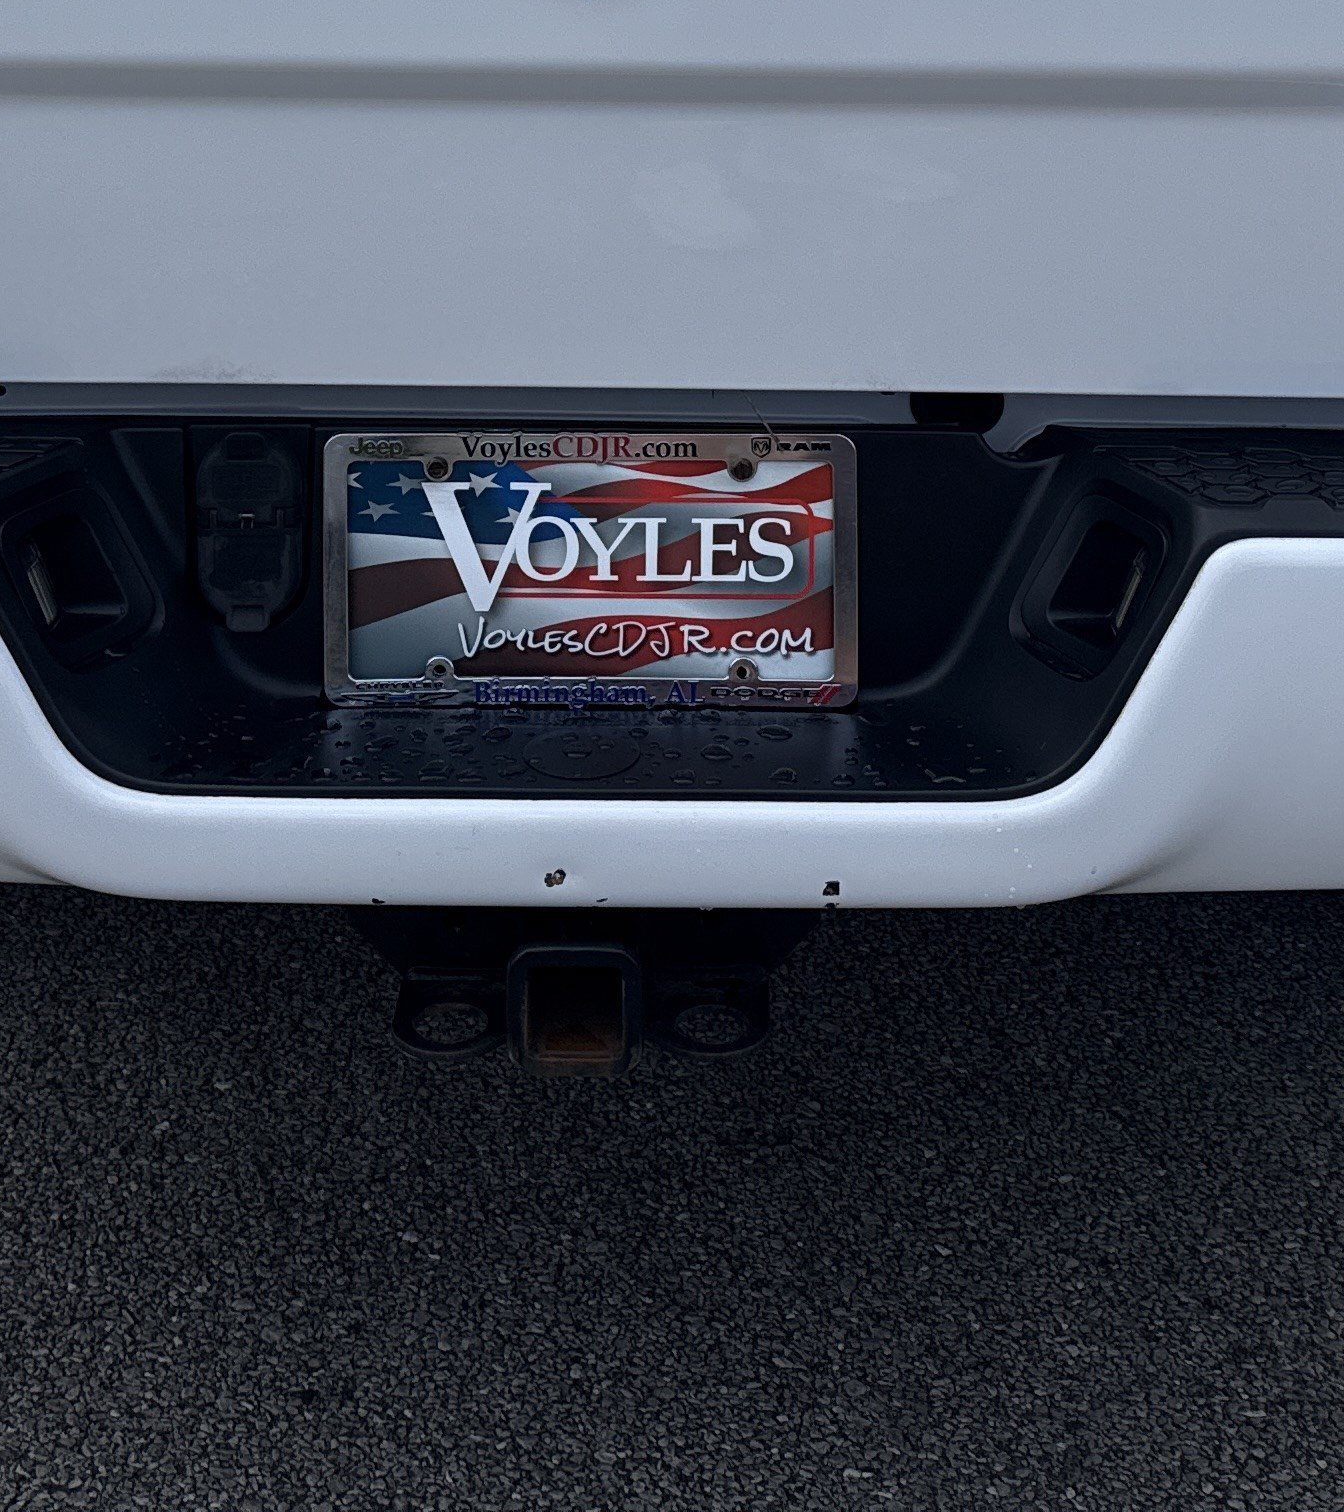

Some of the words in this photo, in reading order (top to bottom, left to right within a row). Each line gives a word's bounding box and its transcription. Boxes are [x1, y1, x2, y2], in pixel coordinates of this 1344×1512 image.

[349, 437, 404, 458] Jeep
[460, 435, 698, 464] VoylesCDJR.com
[777, 441, 832, 452] RAM
[421, 482, 794, 612] VOYLES
[474, 679, 656, 709] Birmingham,
[665, 679, 705, 704] AL
[711, 686, 820, 698] DODGE
